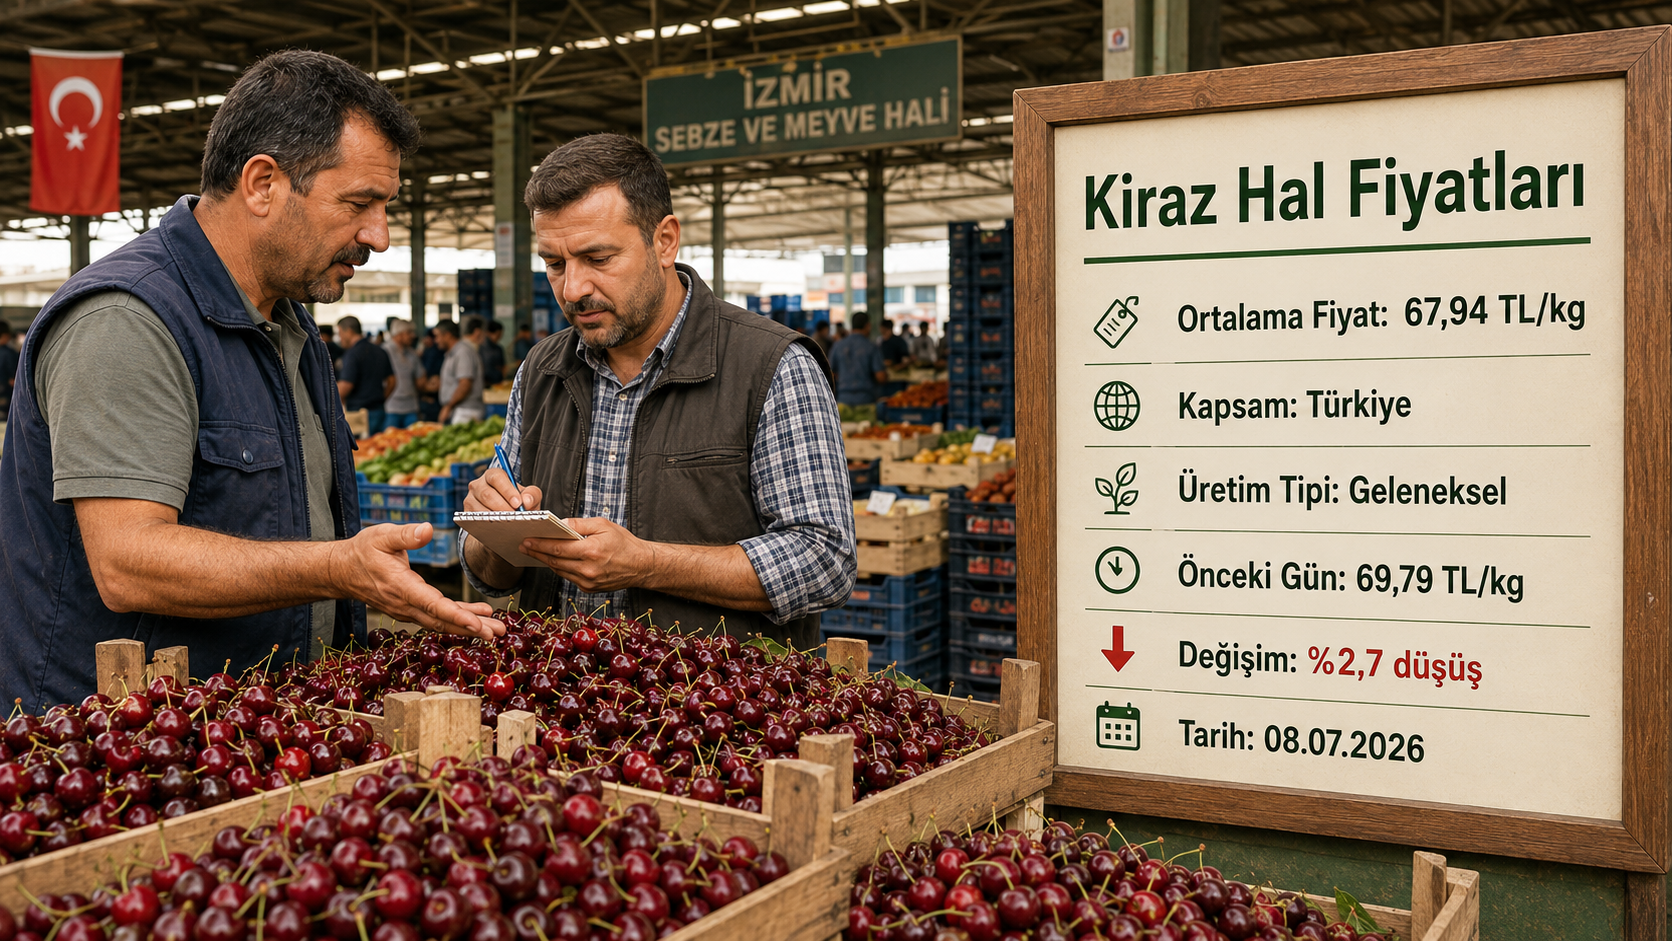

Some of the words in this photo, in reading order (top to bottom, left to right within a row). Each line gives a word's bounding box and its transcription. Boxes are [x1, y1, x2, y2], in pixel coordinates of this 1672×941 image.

[743, 62, 852, 110] İZMİR
[655, 119, 736, 153] SEBZE
[742, 114, 777, 143] VE
[784, 104, 877, 138] MEYVE
[884, 87, 950, 131] HALİ
[1085, 172, 1218, 231] Kiraz
[1238, 160, 1324, 223] Hal
[1350, 149, 1584, 232] Fiyatları
[1177, 302, 1303, 333] Ortalama
[1313, 299, 1388, 336] Fiyat:
[1404, 295, 1489, 331] 67,94
[1498, 291, 1585, 331] TL/kg
[1179, 391, 1297, 427] Kapsam:
[1306, 388, 1412, 426] Türkiye
[1179, 468, 1270, 503] Üretim
[1279, 474, 1339, 511] Tipi:
[1349, 475, 1506, 506] Geleneksel
[1178, 553, 1271, 589] Önceki
[1281, 561, 1346, 592] Gün:
[1356, 563, 1433, 598] 69,79
[1441, 565, 1524, 604] TL/kg
[1179, 640, 1297, 679] Değişim:
[1307, 645, 1383, 682] %2,7
[1393, 649, 1483, 691] düşüş
[1178, 718, 1254, 751] Tarih:
[1264, 724, 1425, 763] 08.07.2026
